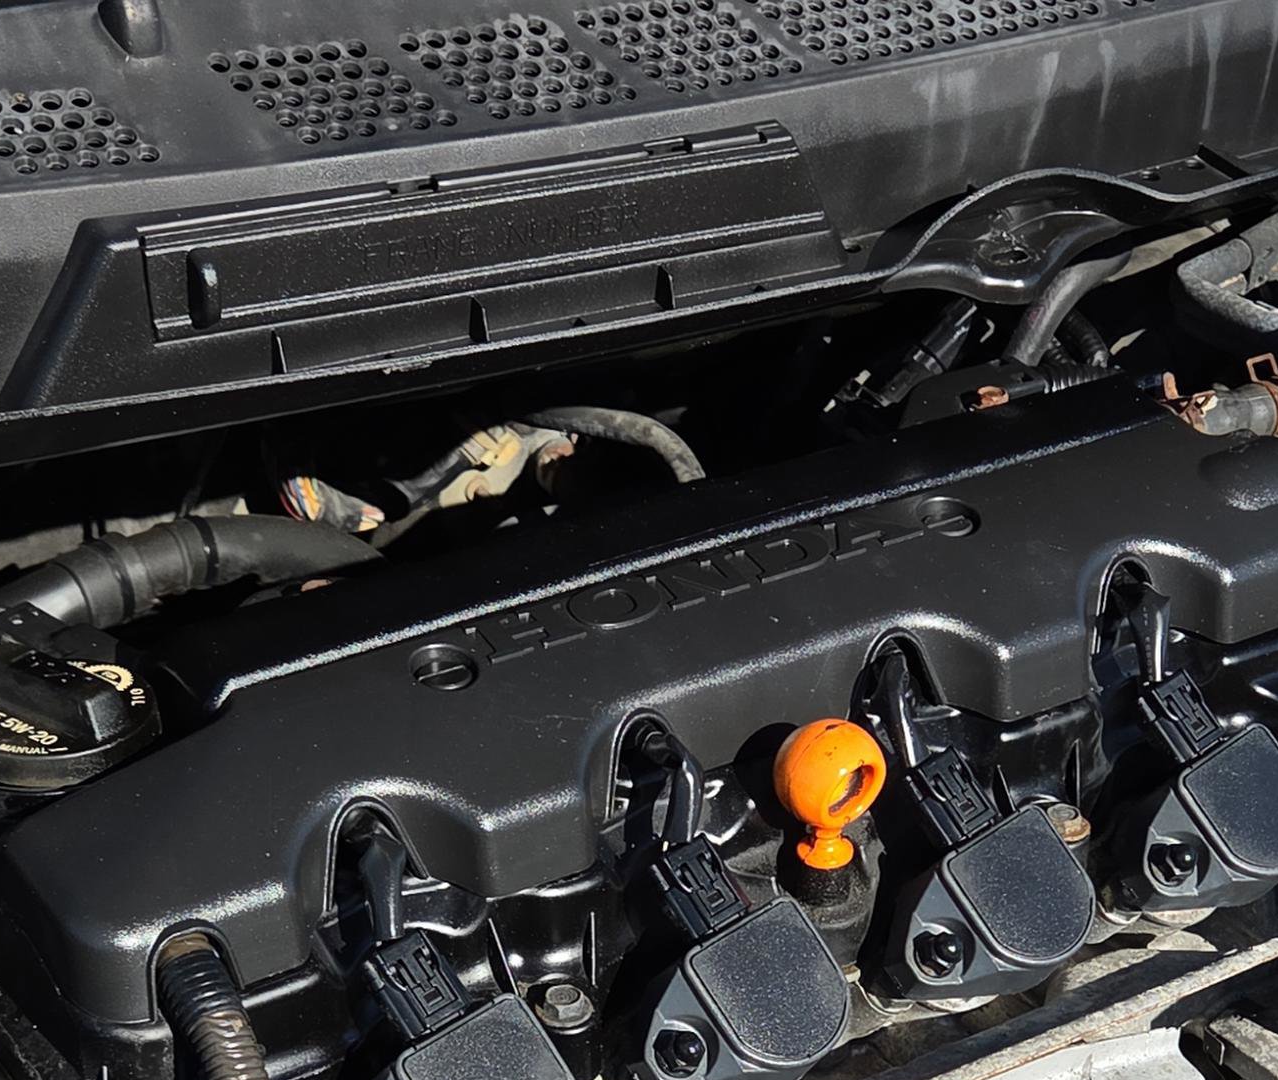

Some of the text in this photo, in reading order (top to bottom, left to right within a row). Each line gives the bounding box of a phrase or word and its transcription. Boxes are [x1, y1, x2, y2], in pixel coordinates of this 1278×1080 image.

[463, 518, 925, 664] HONDA
[129, 687, 146, 707] OIL
[0, 717, 59, 745] 5W-20
